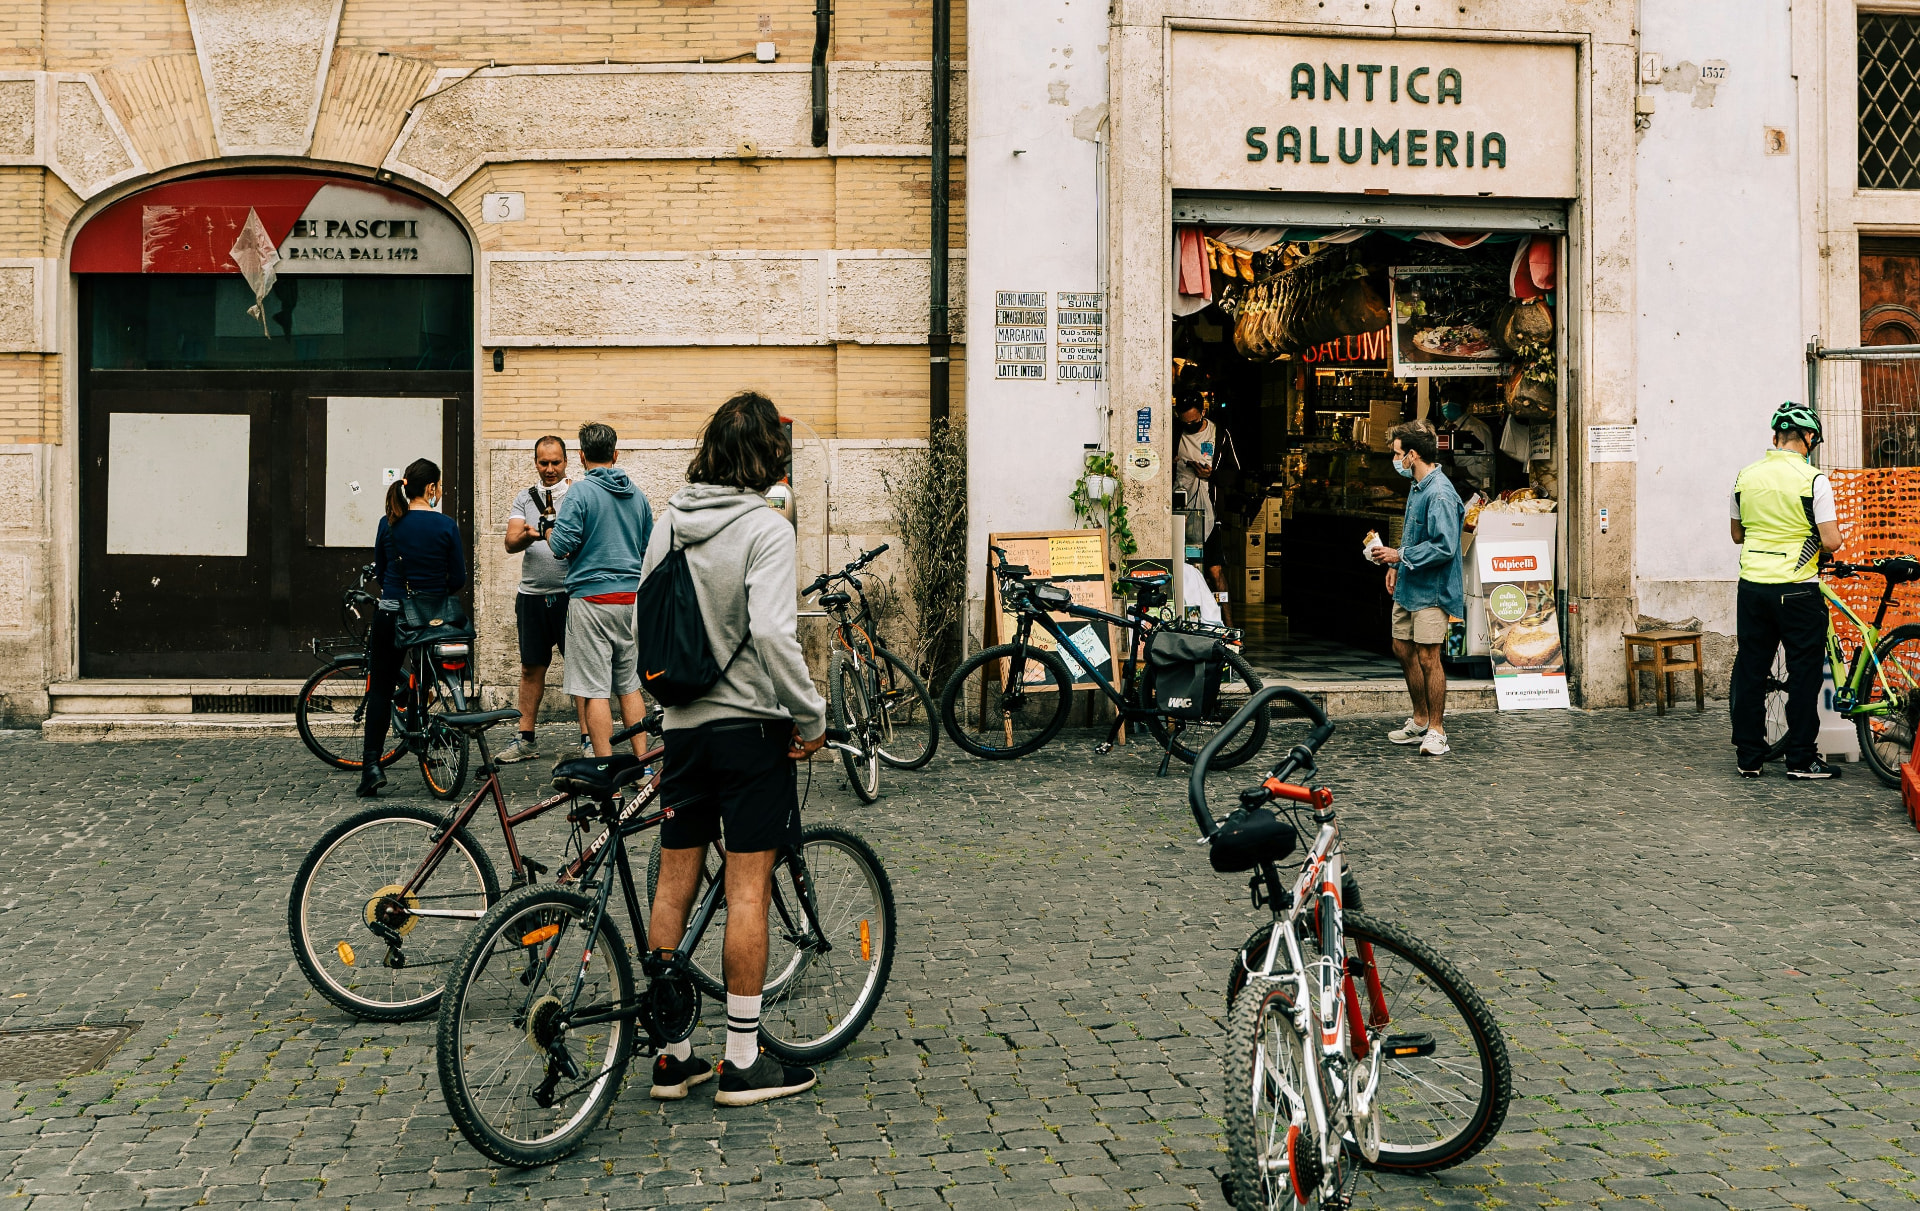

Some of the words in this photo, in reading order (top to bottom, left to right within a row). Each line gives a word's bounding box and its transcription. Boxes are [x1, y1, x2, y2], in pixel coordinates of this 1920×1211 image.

[1643, 57, 1658, 78] 4
[1290, 62, 1462, 105] ANTICA
[1246, 126, 1508, 169] SALUMERIA
[497, 195, 511, 219] 3
[288, 247, 344, 260] BANCA
[348, 247, 383, 260] DAL
[387, 247, 418, 260] 1472
[1018, 293, 1045, 307] NATURALE
[1068, 300, 1098, 308] SUINE
[998, 328, 1045, 342] MARGARINA
[998, 365, 1018, 377] LATTE
[1020, 365, 1043, 377] INTERO
[1059, 365, 1077, 379] OLIO
[1493, 558, 1534, 571] Volpicelli
[1167, 697, 1193, 709] WAG
